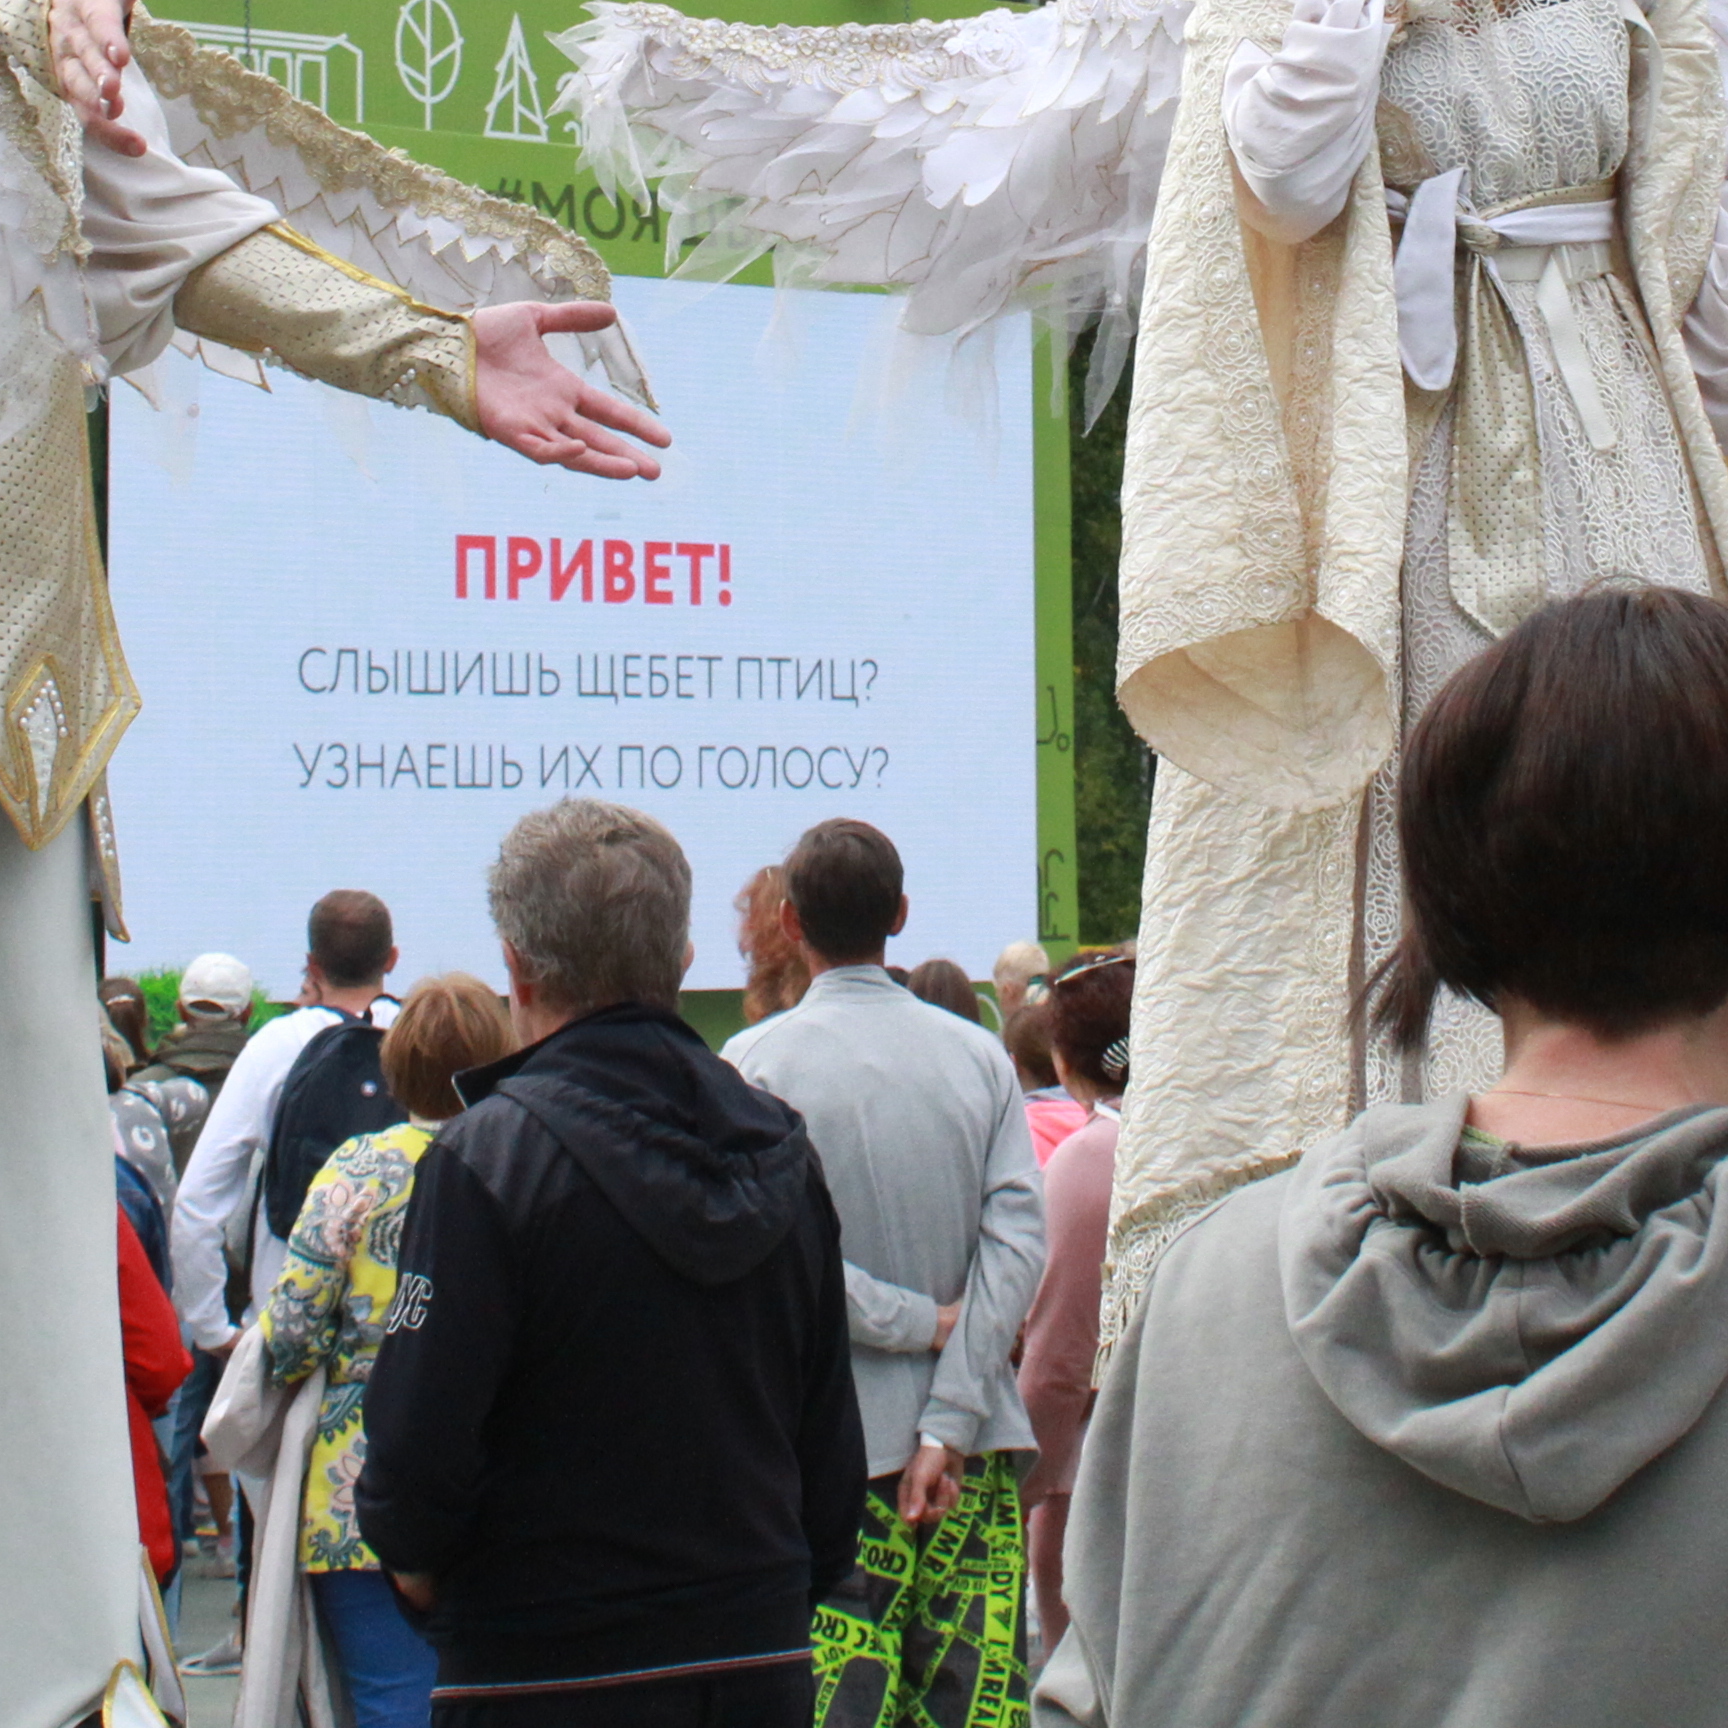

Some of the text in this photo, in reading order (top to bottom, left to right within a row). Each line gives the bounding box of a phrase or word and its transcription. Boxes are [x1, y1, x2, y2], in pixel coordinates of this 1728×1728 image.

[455, 534, 732, 607] ПРИВЕТ!
[298, 647, 879, 708] СЛЫШИШЬ ЩЕБЕТ ПТИЦ?
[293, 743, 890, 791] УЗНАЕШЬ ИХ ПО ГОЛОСУ?
